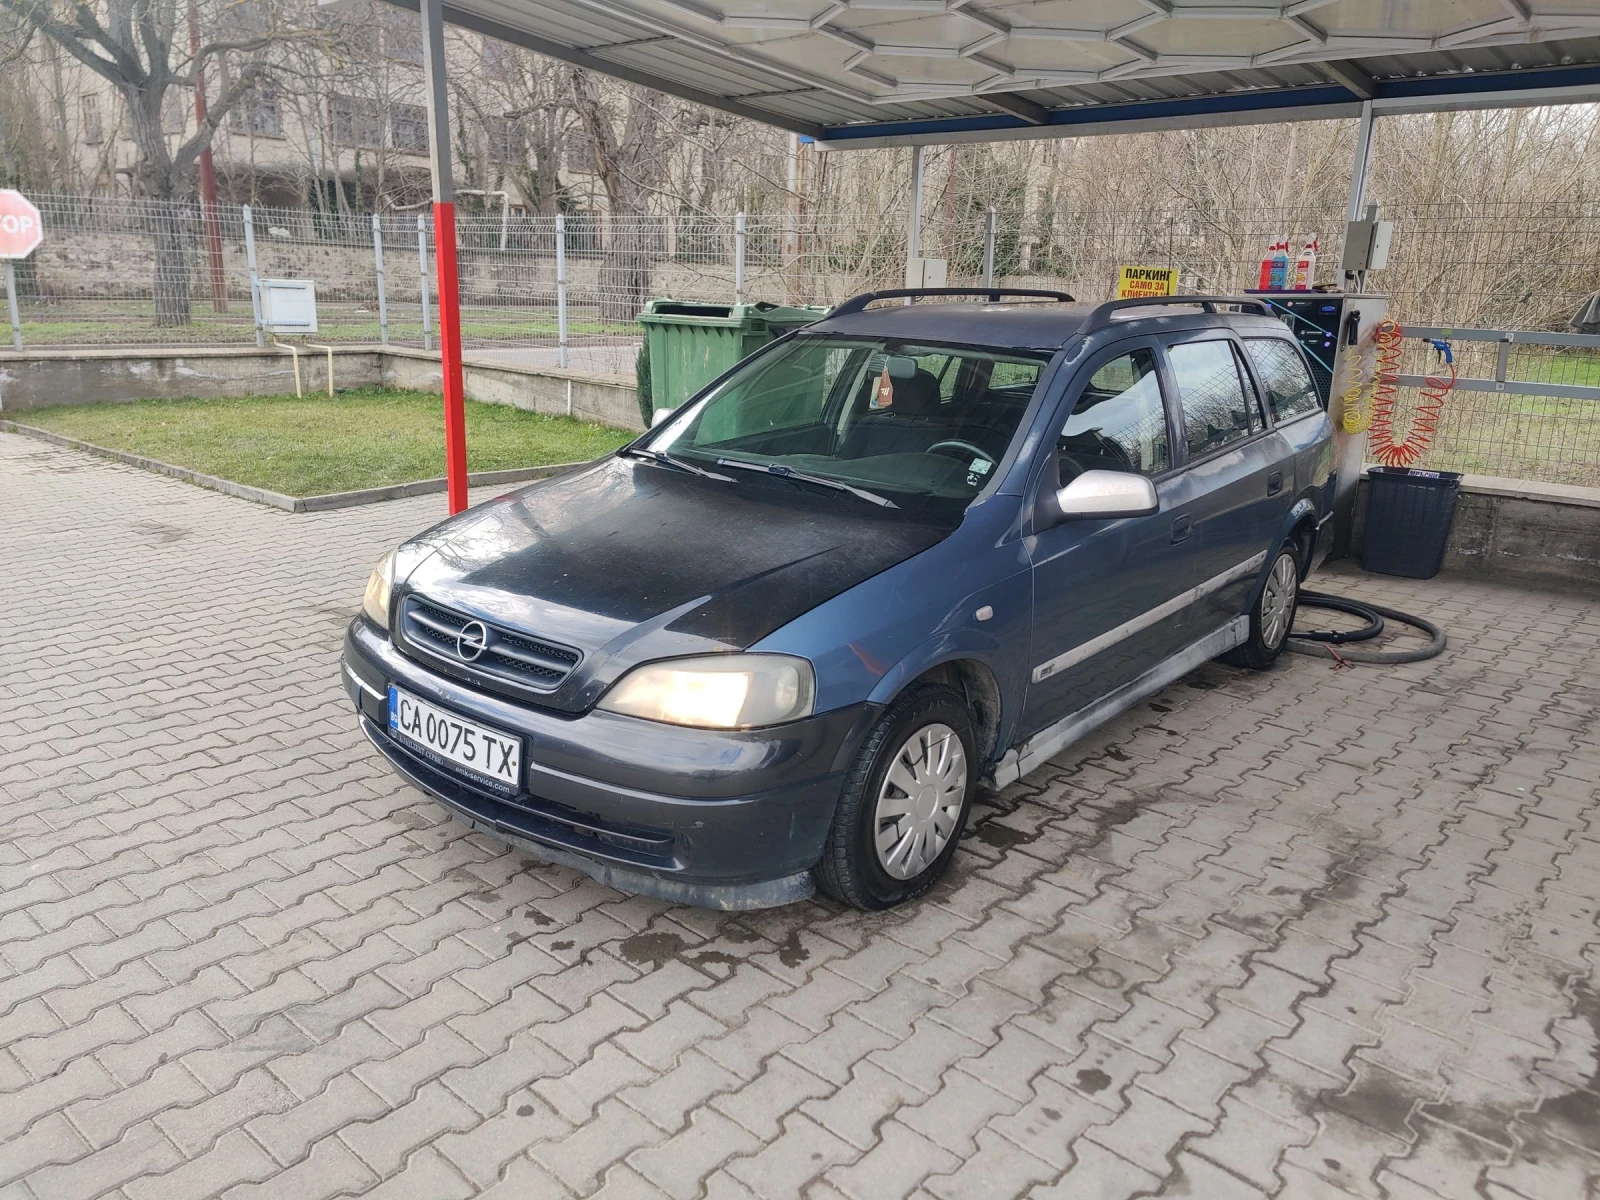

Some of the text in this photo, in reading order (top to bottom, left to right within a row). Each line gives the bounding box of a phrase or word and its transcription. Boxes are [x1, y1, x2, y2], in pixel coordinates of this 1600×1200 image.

[0, 214, 33, 234] OP
[1125, 268, 1173, 281] ПАРКИНГ
[1129, 280, 1165, 291] САМО ЗА
